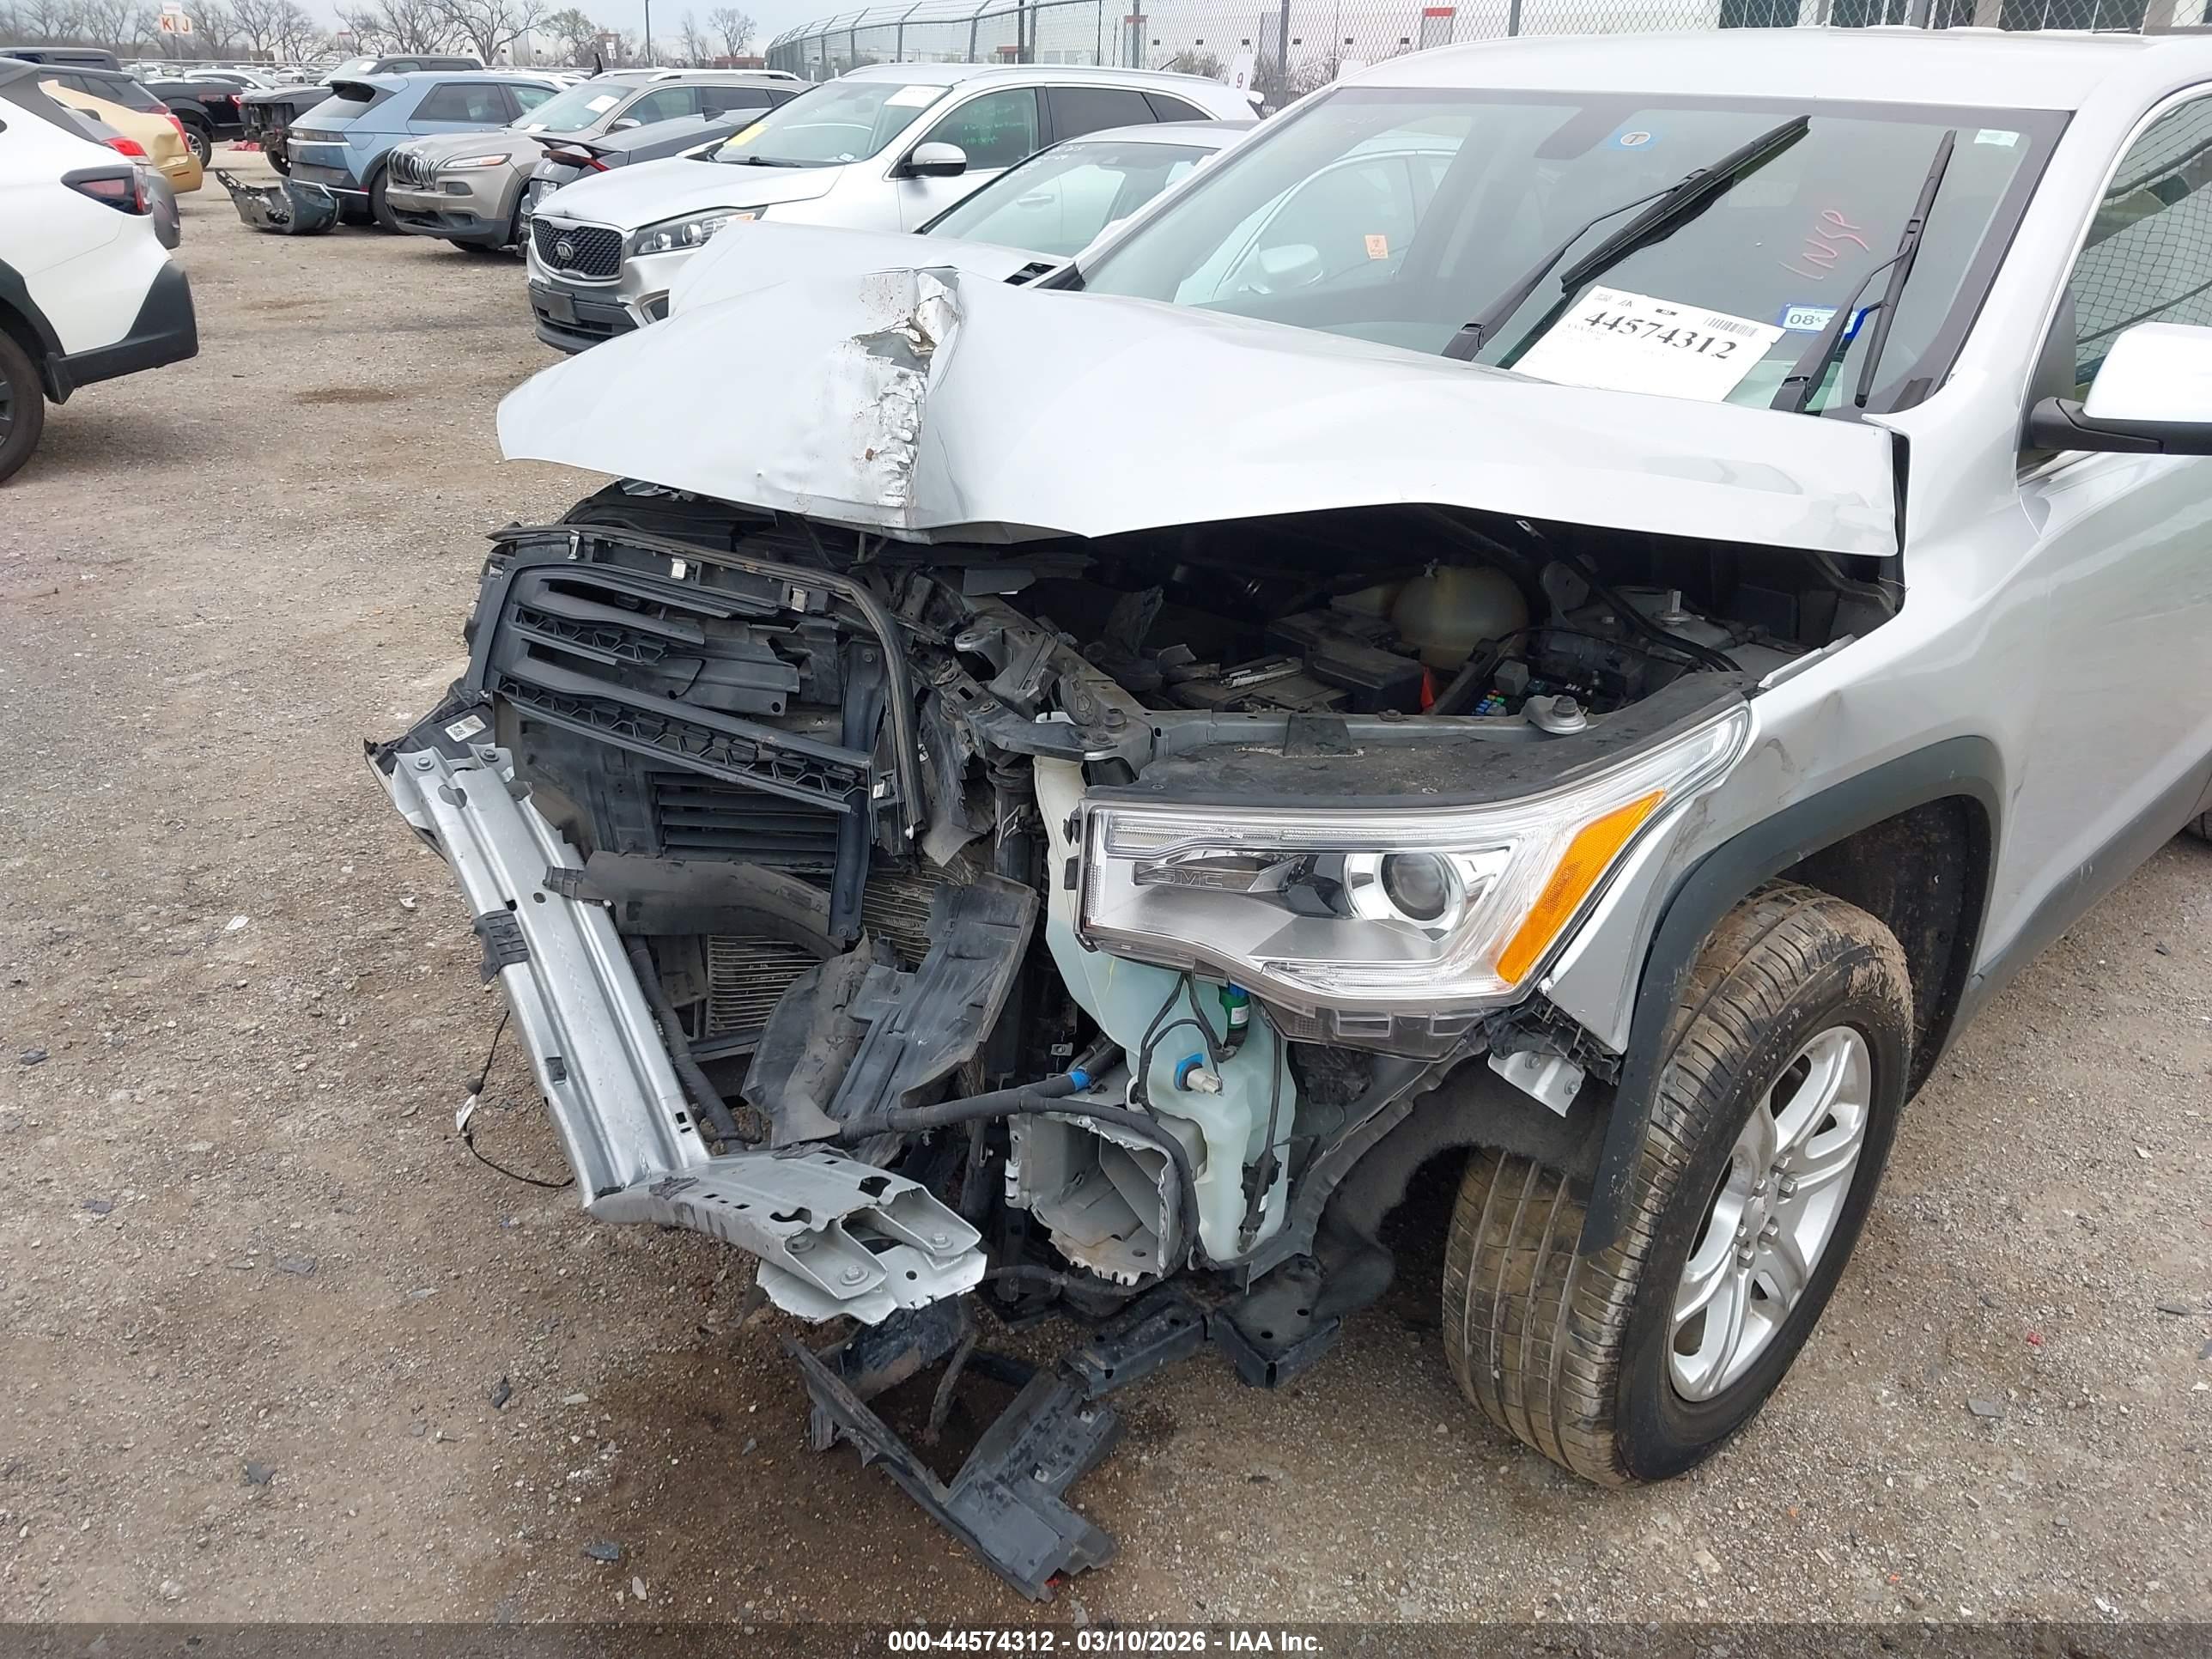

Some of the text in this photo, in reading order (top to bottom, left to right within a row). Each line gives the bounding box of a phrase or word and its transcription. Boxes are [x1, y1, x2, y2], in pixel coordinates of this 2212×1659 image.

[162, 17, 173, 31] K
[182, 19, 189, 32] J
[1237, 72, 1243, 88] 9
[1790, 314, 1814, 325] 08
[1584, 311, 1737, 359] 44574312
